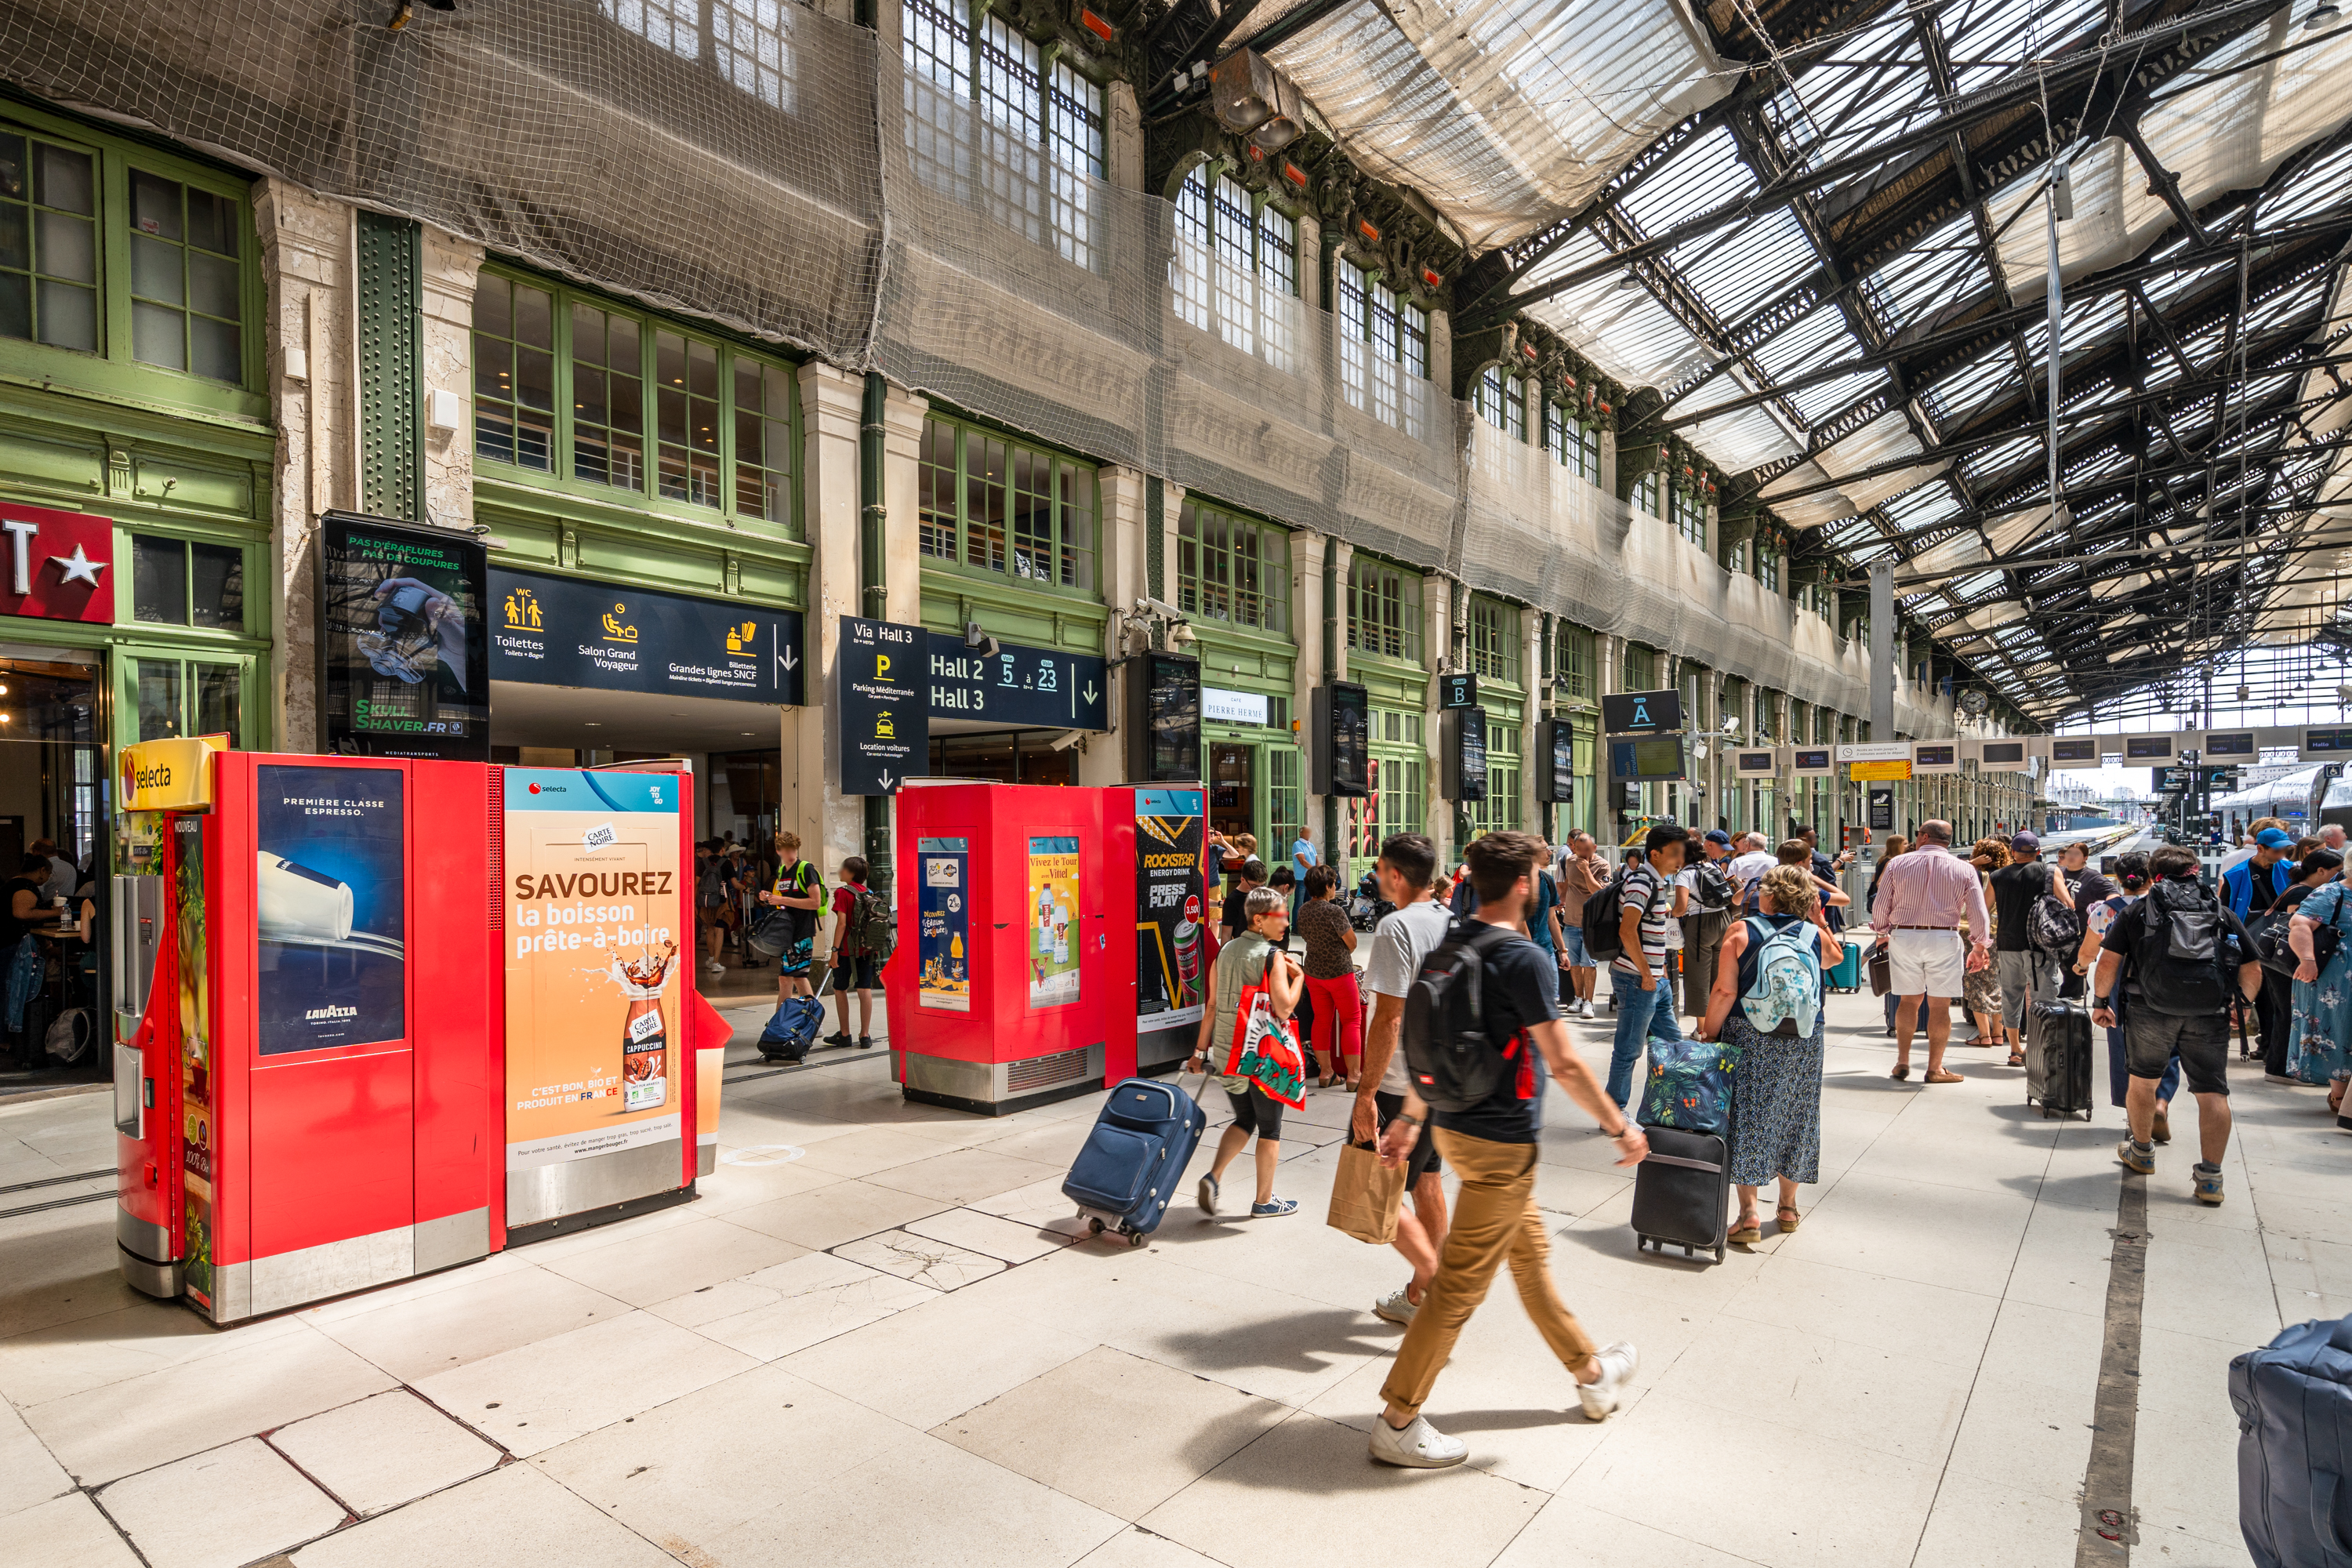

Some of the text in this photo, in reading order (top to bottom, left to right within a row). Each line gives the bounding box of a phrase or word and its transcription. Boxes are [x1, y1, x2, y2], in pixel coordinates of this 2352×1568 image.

[349, 536, 444, 558] PAS D'ÉRAFLURES
[2, 518, 39, 594] T
[362, 550, 459, 571] PAS DE COUPURES
[516, 588, 532, 597] WC
[854, 622, 913, 644] Via Hall 3
[495, 635, 544, 650] Toilettes
[579, 644, 636, 660] Salon Grand
[594, 657, 639, 672] Voyageur
[669, 662, 757, 680] Grandes lignes SNCF
[728, 661, 757, 670] Billetterie
[877, 654, 891, 677] P
[931, 654, 1057, 688] Hall 2 5 à 23
[853, 683, 914, 696] Parking Méditerranée
[1454, 688, 1465, 702] B
[931, 685, 984, 710] Hall 3
[1208, 704, 1263, 718] PIERRE HERMÉ
[1633, 705, 1650, 723] A
[859, 742, 886, 751] Location
[136, 763, 171, 789] selecta
[283, 797, 385, 808] PREMIÈRE CLASSE
[304, 808, 365, 816] ESPRESSO.
[174, 820, 198, 833] NOUVEAU
[587, 827, 612, 841] CARTE
[590, 833, 614, 848] NOIRE
[1029, 857, 1078, 866] Vivez le Tour
[1144, 853, 1195, 869] ROCKSTAR
[1049, 868, 1068, 879] Vittel
[1149, 868, 1172, 877] ENERGY
[515, 871, 673, 900] SAVOUREZ
[1149, 884, 1186, 897] PRESS
[1149, 895, 1178, 908] PLAY
[517, 902, 634, 927] la boisson
[517, 923, 670, 959] prête-à-boire
[305, 1004, 358, 1020] LAVAZZA
[634, 1015, 657, 1030] CARTE
[637, 1021, 659, 1036] NOIRE
[627, 1041, 662, 1054] CAPPUCCINO
[532, 1076, 618, 1097] C'EST BON, BIO ET
[517, 1095, 564, 1111] PRODUIT
[564, 1093, 579, 1104] EN
[580, 1087, 618, 1101] FRANCE
[546, 1143, 562, 1152] santé,
[588, 1136, 605, 1145] manger
[574, 1138, 629, 1154] www.mangerbouger.fr
[186, 1150, 209, 1173] 100% Bio
